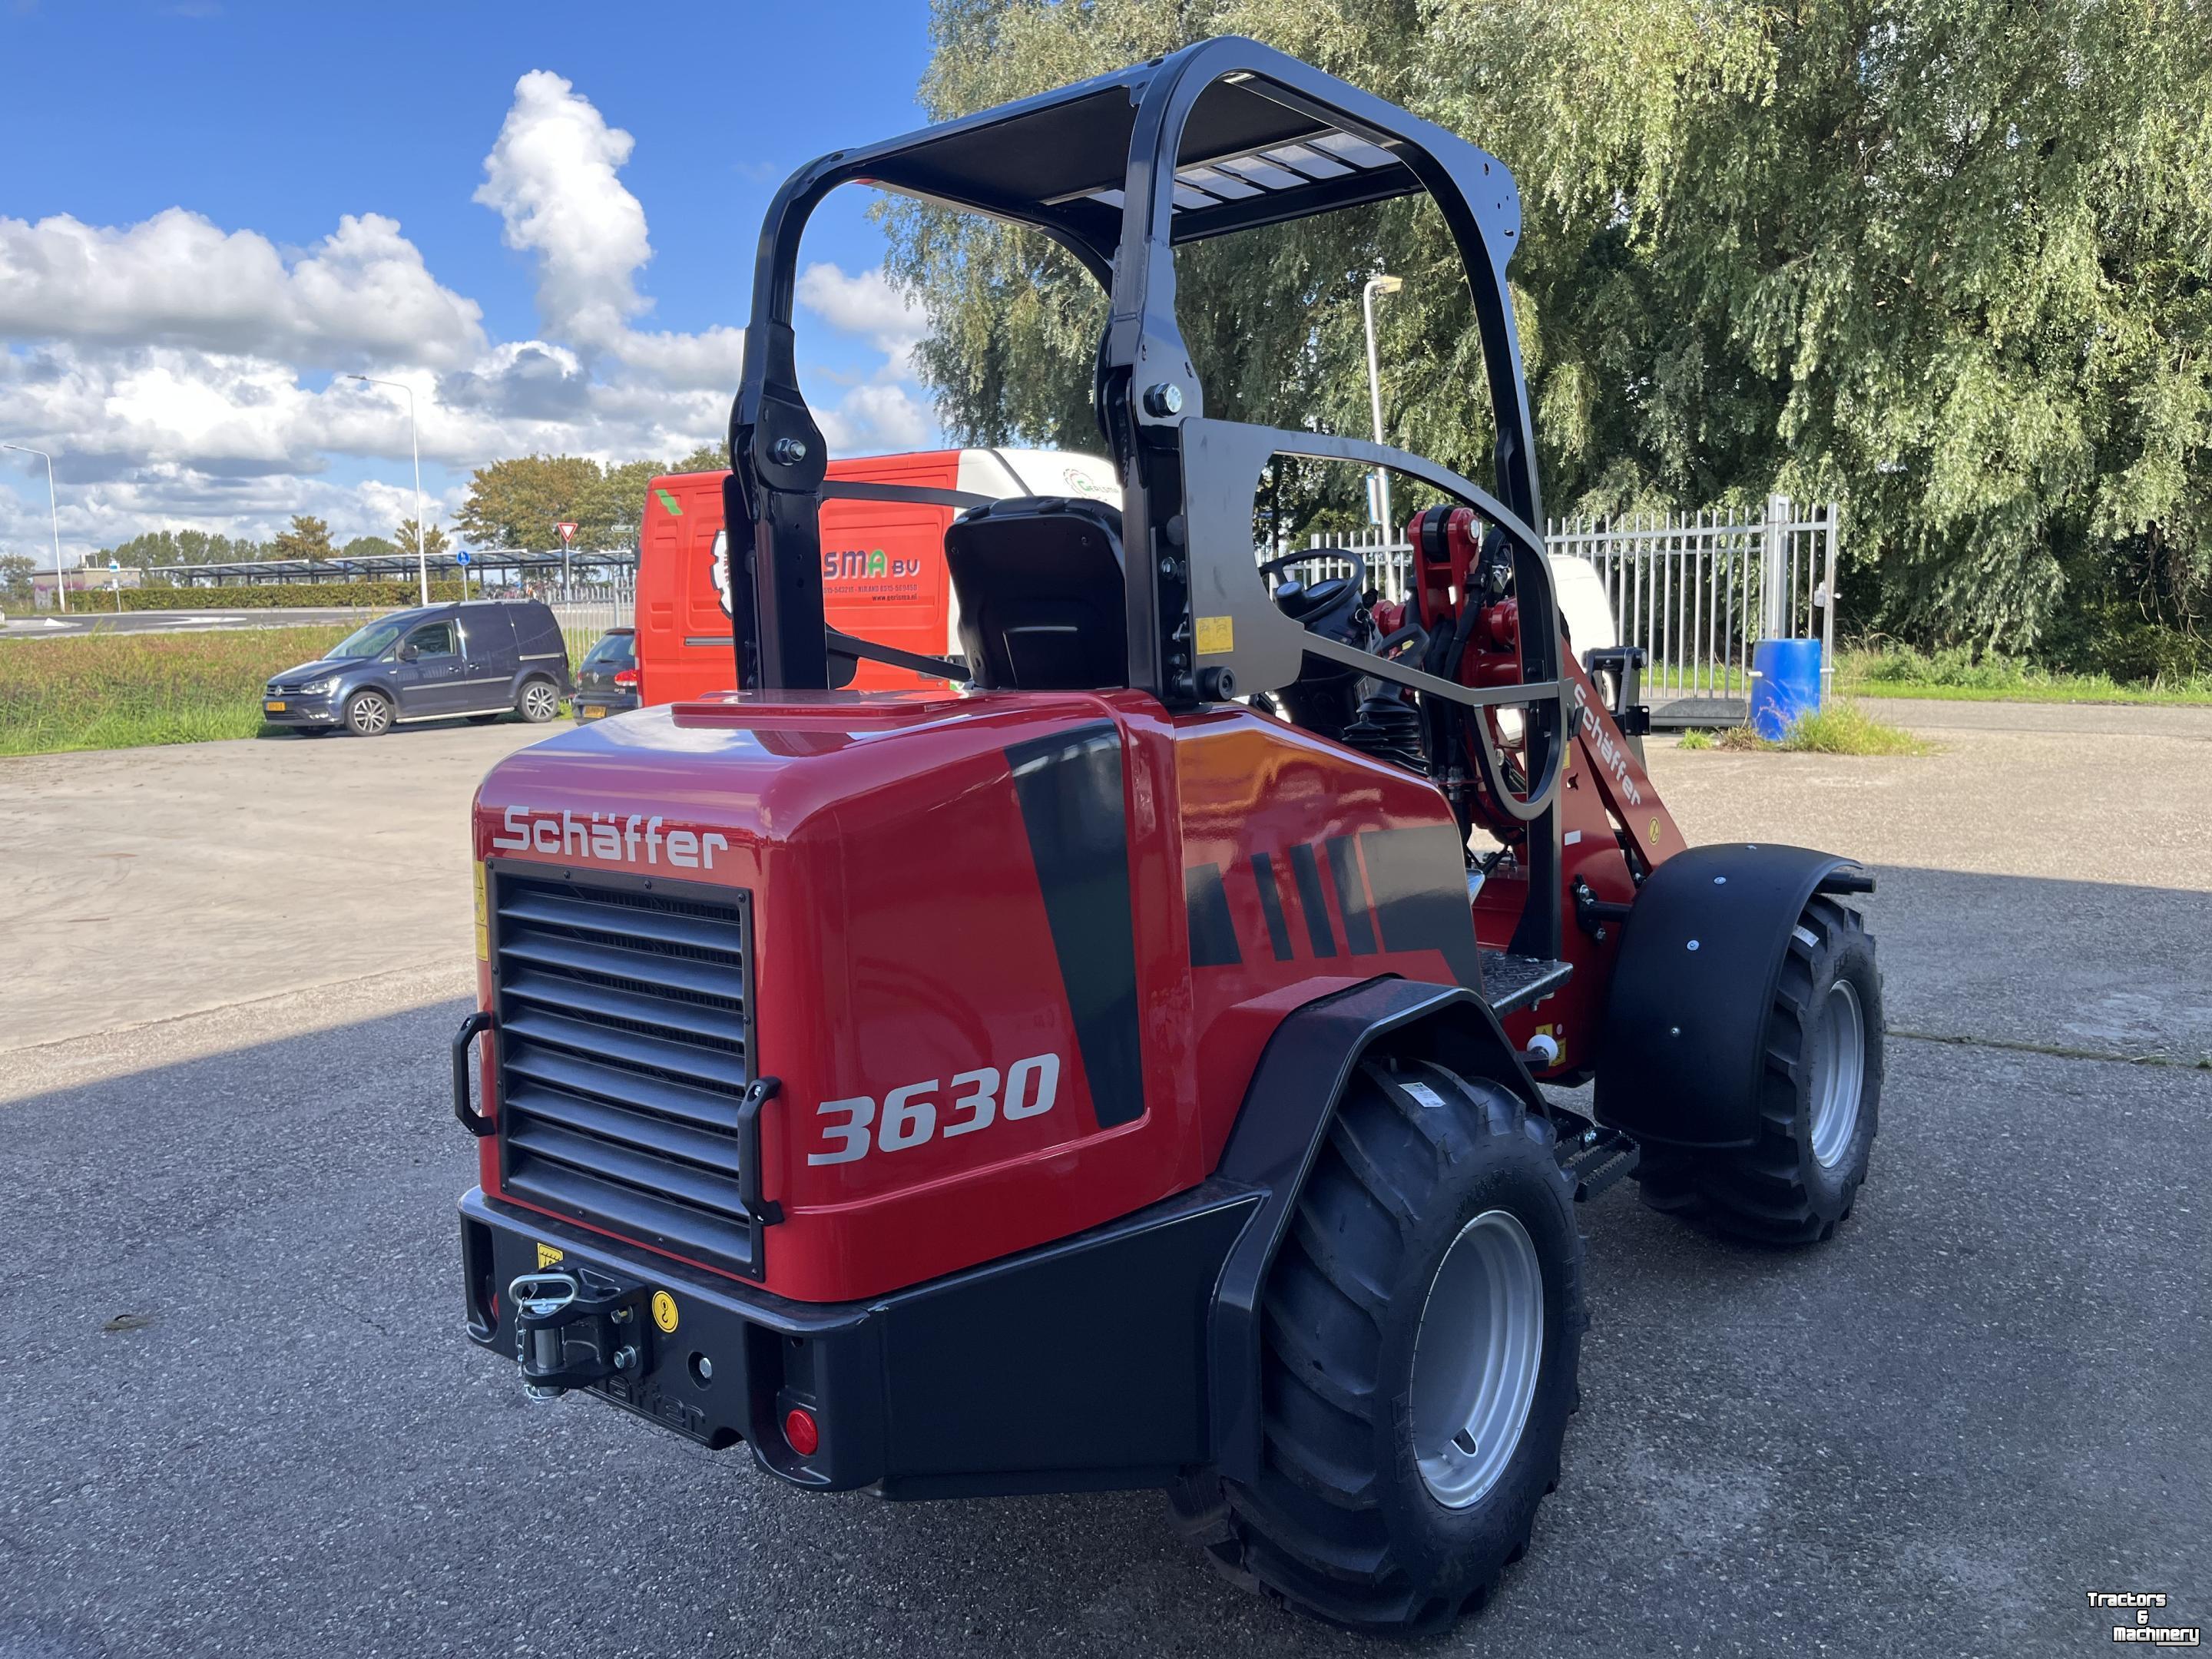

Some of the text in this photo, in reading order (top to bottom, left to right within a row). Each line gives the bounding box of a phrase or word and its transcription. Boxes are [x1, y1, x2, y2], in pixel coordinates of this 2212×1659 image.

[823, 549, 888, 580] SMA
[1575, 683, 1641, 806] Schäffer
[492, 805, 729, 870] Schäffer
[807, 1052, 1061, 1167] 3630
